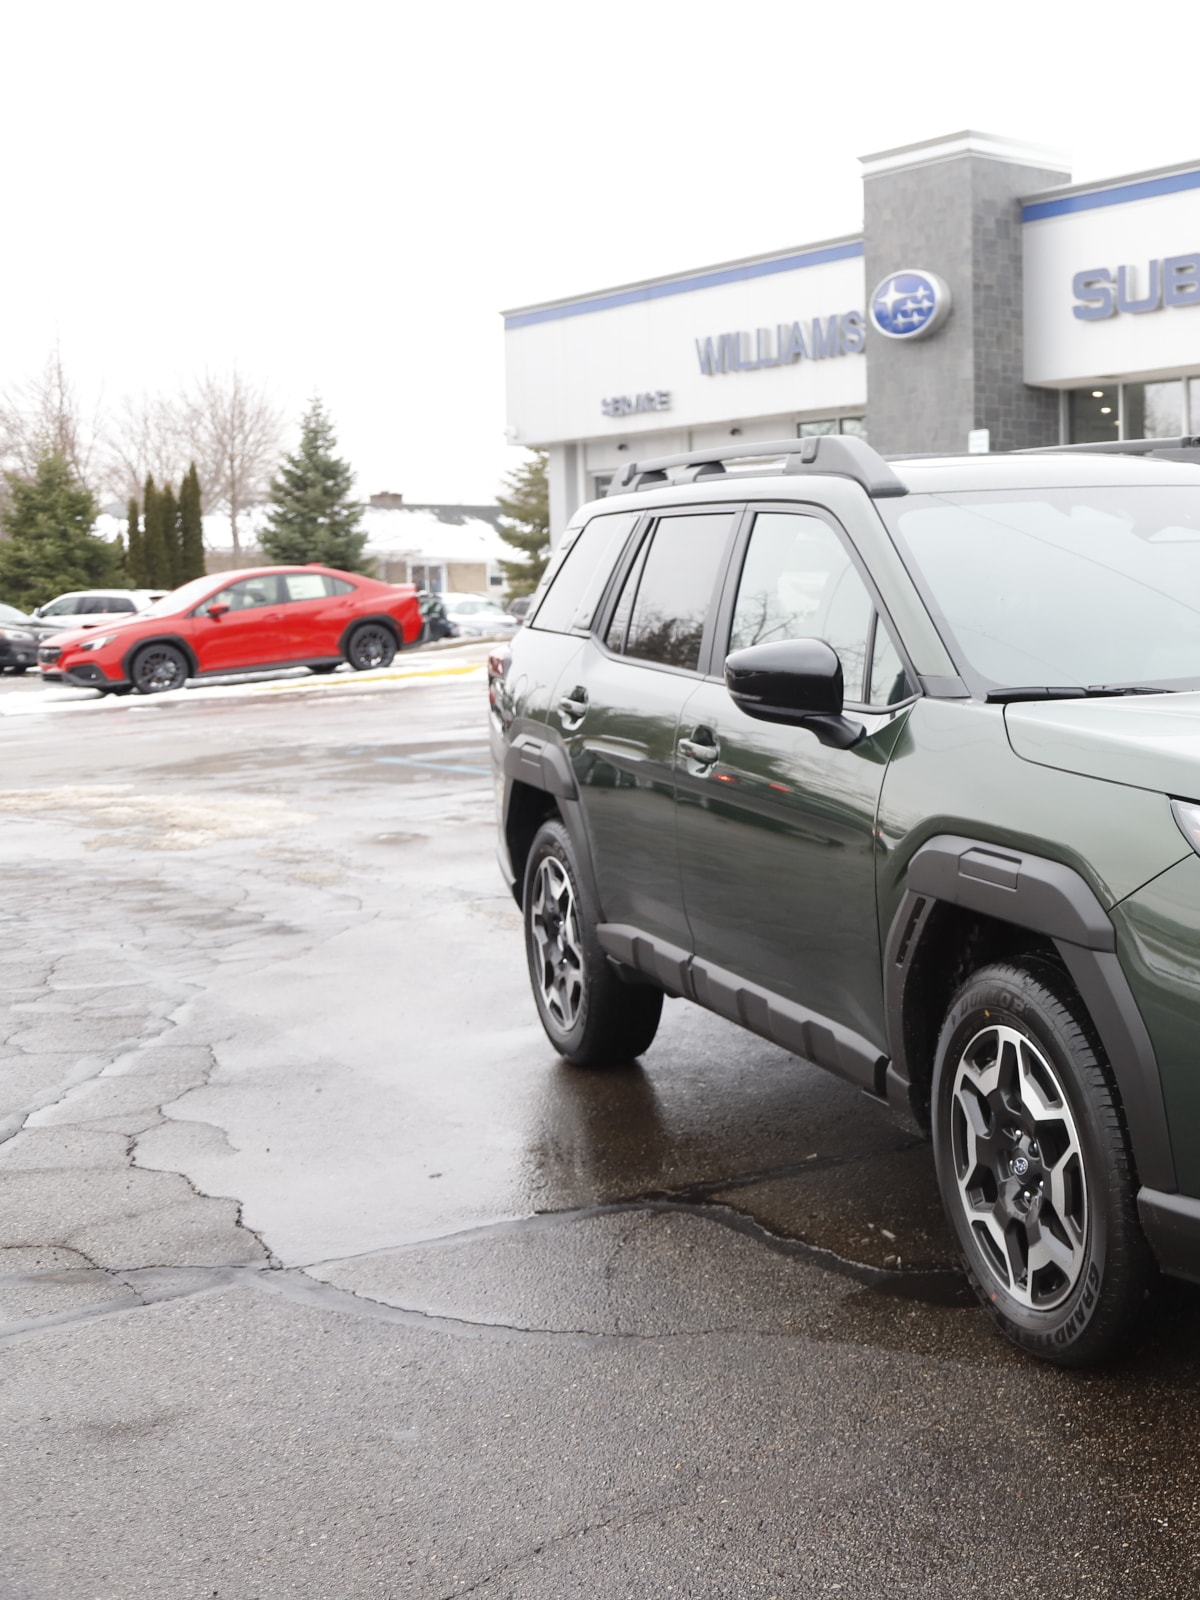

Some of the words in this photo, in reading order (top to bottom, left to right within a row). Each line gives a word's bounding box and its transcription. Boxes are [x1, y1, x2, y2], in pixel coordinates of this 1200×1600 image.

[695, 310, 865, 376] WILLIAMS
[960, 990, 1026, 1018] DUOP
[1008, 1261, 1100, 1346] GRANDT
